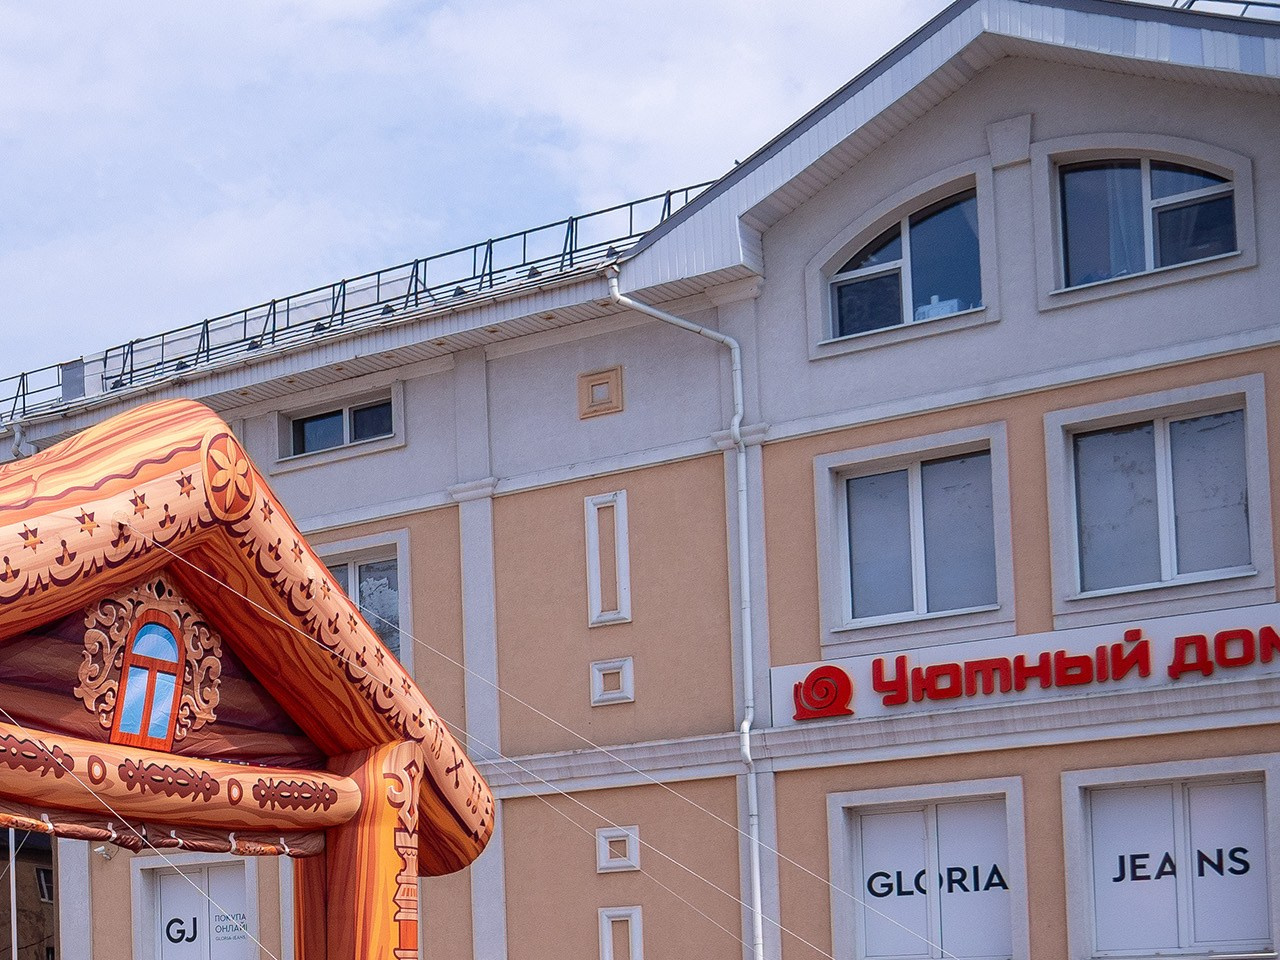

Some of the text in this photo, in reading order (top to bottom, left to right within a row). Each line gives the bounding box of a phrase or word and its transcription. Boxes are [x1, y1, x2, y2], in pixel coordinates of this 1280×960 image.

[871, 628, 1152, 706] Уютный
[866, 863, 1009, 898] GLORIA
[1113, 846, 1251, 884] JEANS
[165, 917, 198, 944] GJ
